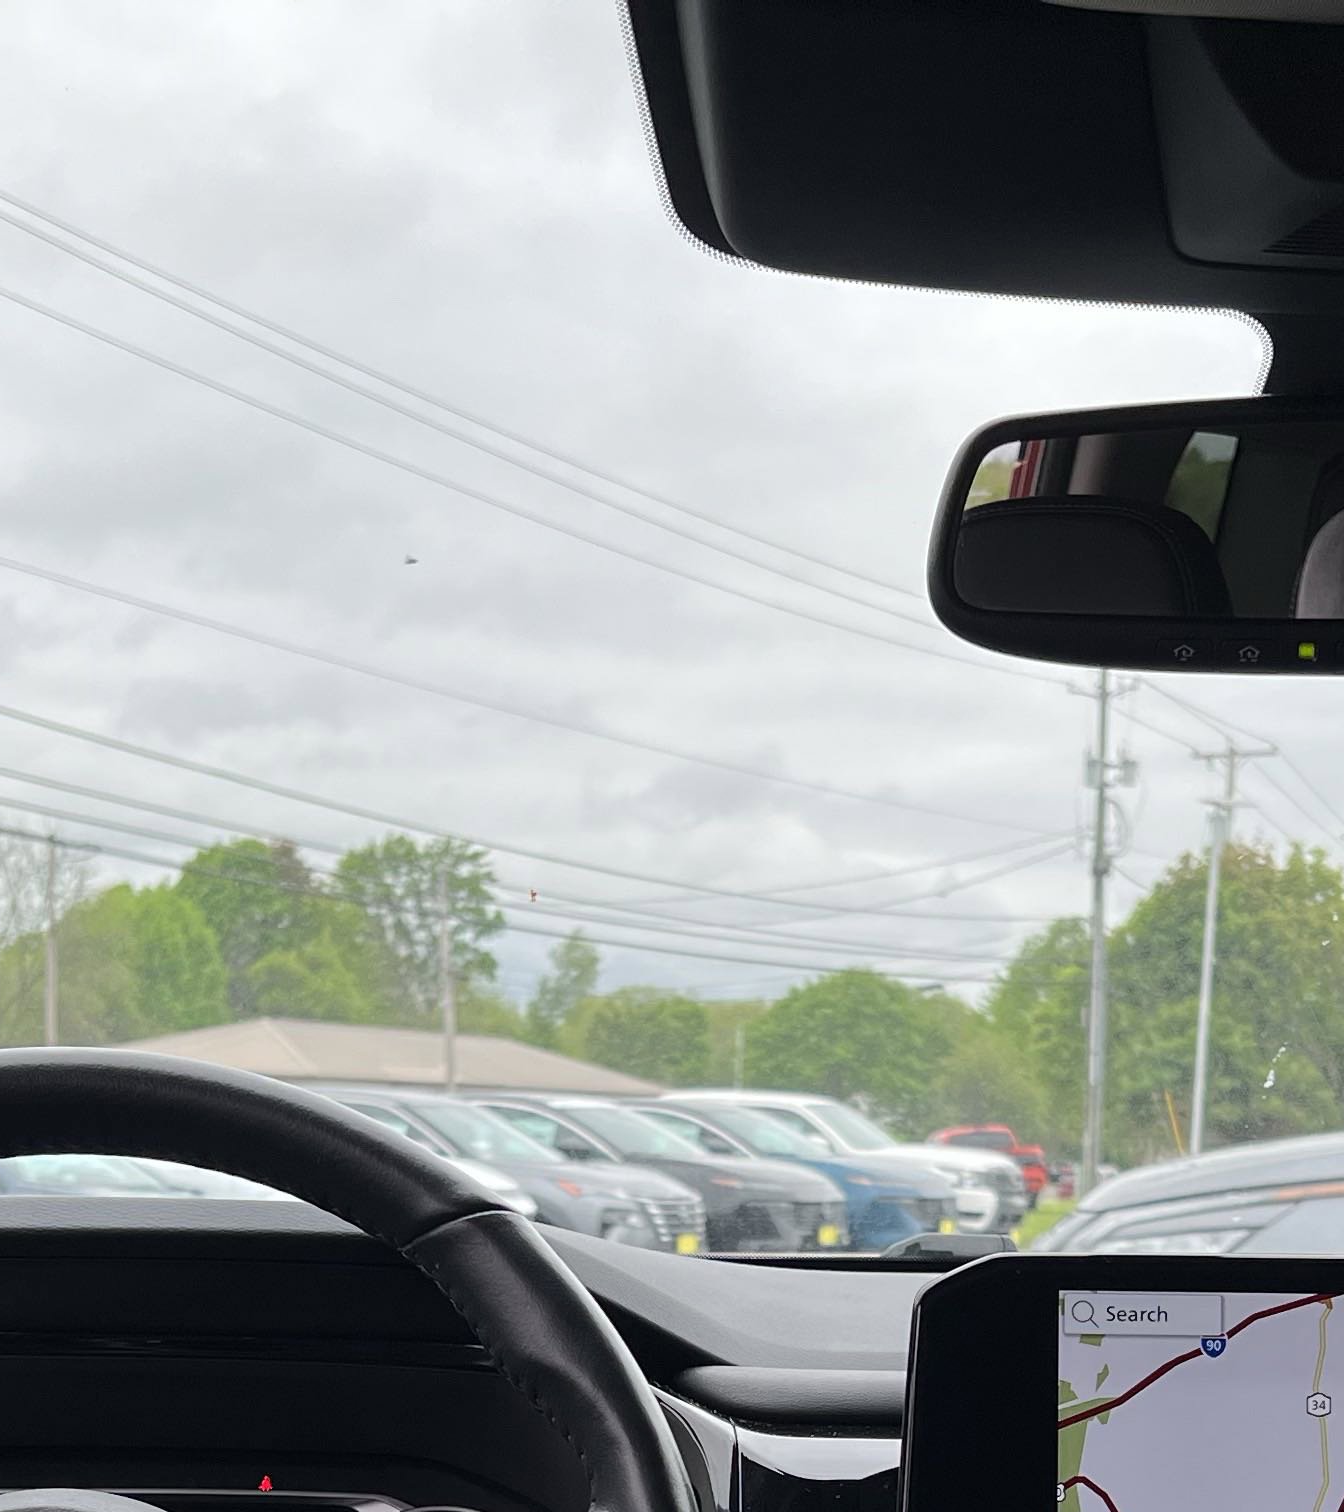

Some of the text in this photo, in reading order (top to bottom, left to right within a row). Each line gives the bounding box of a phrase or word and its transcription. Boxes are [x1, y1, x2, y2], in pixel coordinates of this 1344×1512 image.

[1105, 1305, 1168, 1323] Search
[1206, 1339, 1222, 1352] 90
[1311, 1399, 1326, 1411] 34
